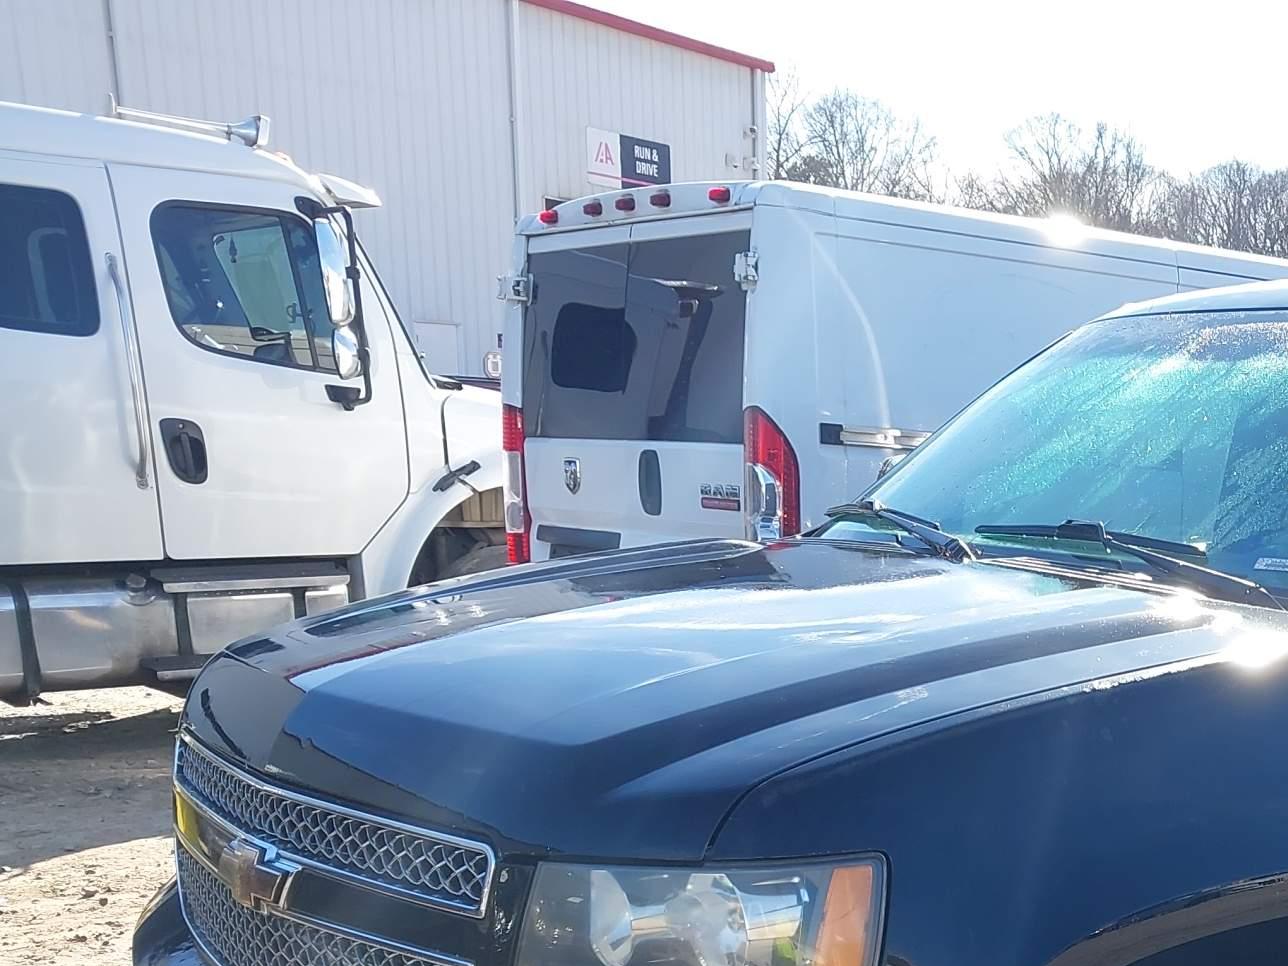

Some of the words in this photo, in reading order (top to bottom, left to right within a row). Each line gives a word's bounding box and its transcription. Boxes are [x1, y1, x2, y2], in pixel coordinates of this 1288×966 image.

[634, 145, 651, 161] RUN
[652, 149, 659, 162] &
[635, 161, 659, 177] DRIVE
